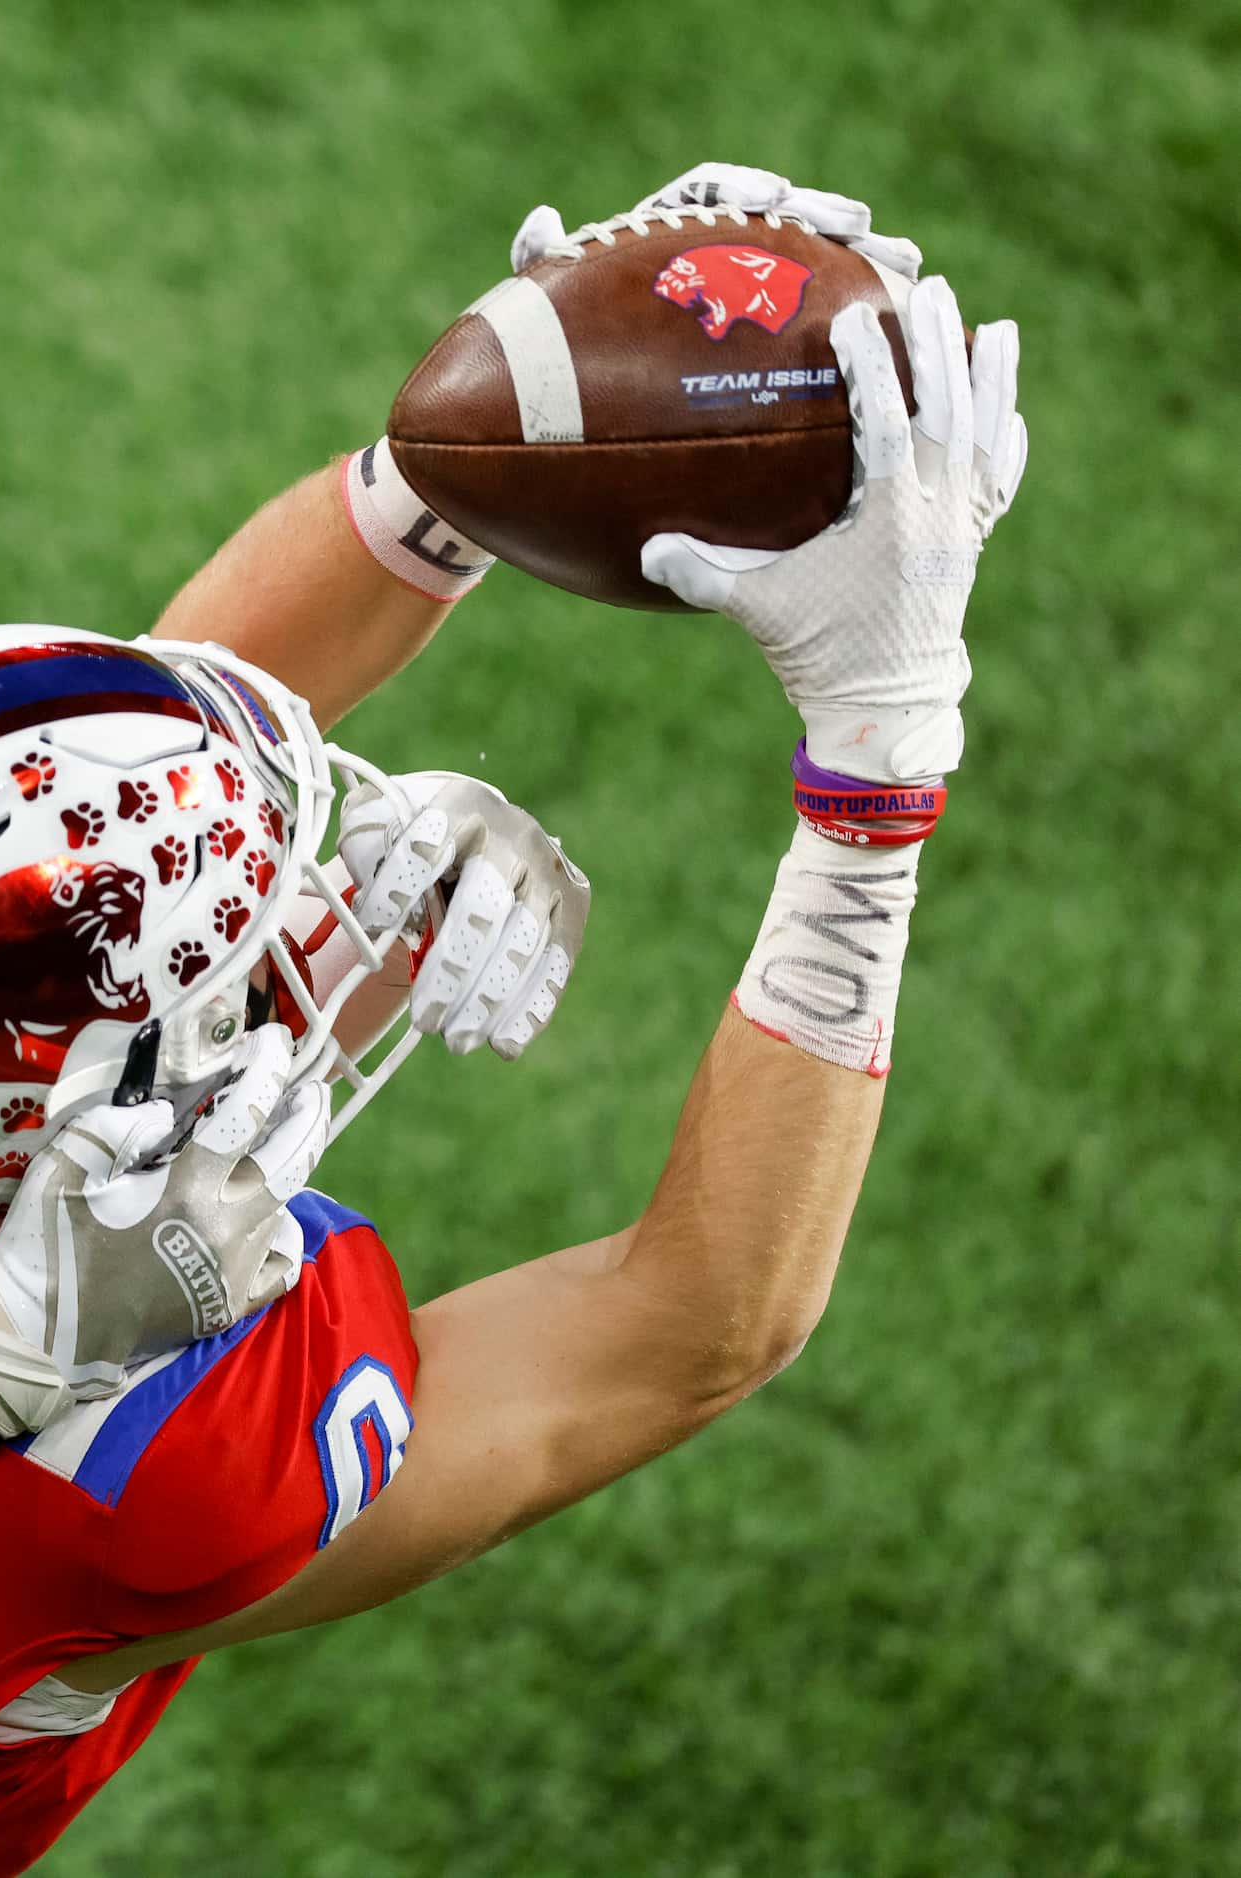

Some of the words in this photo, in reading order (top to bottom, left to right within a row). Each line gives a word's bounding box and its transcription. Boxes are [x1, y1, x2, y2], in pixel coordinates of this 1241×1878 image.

[681, 373, 761, 393] TEAM
[766, 369, 837, 387] ISSUE
[816, 823, 852, 842] Football
